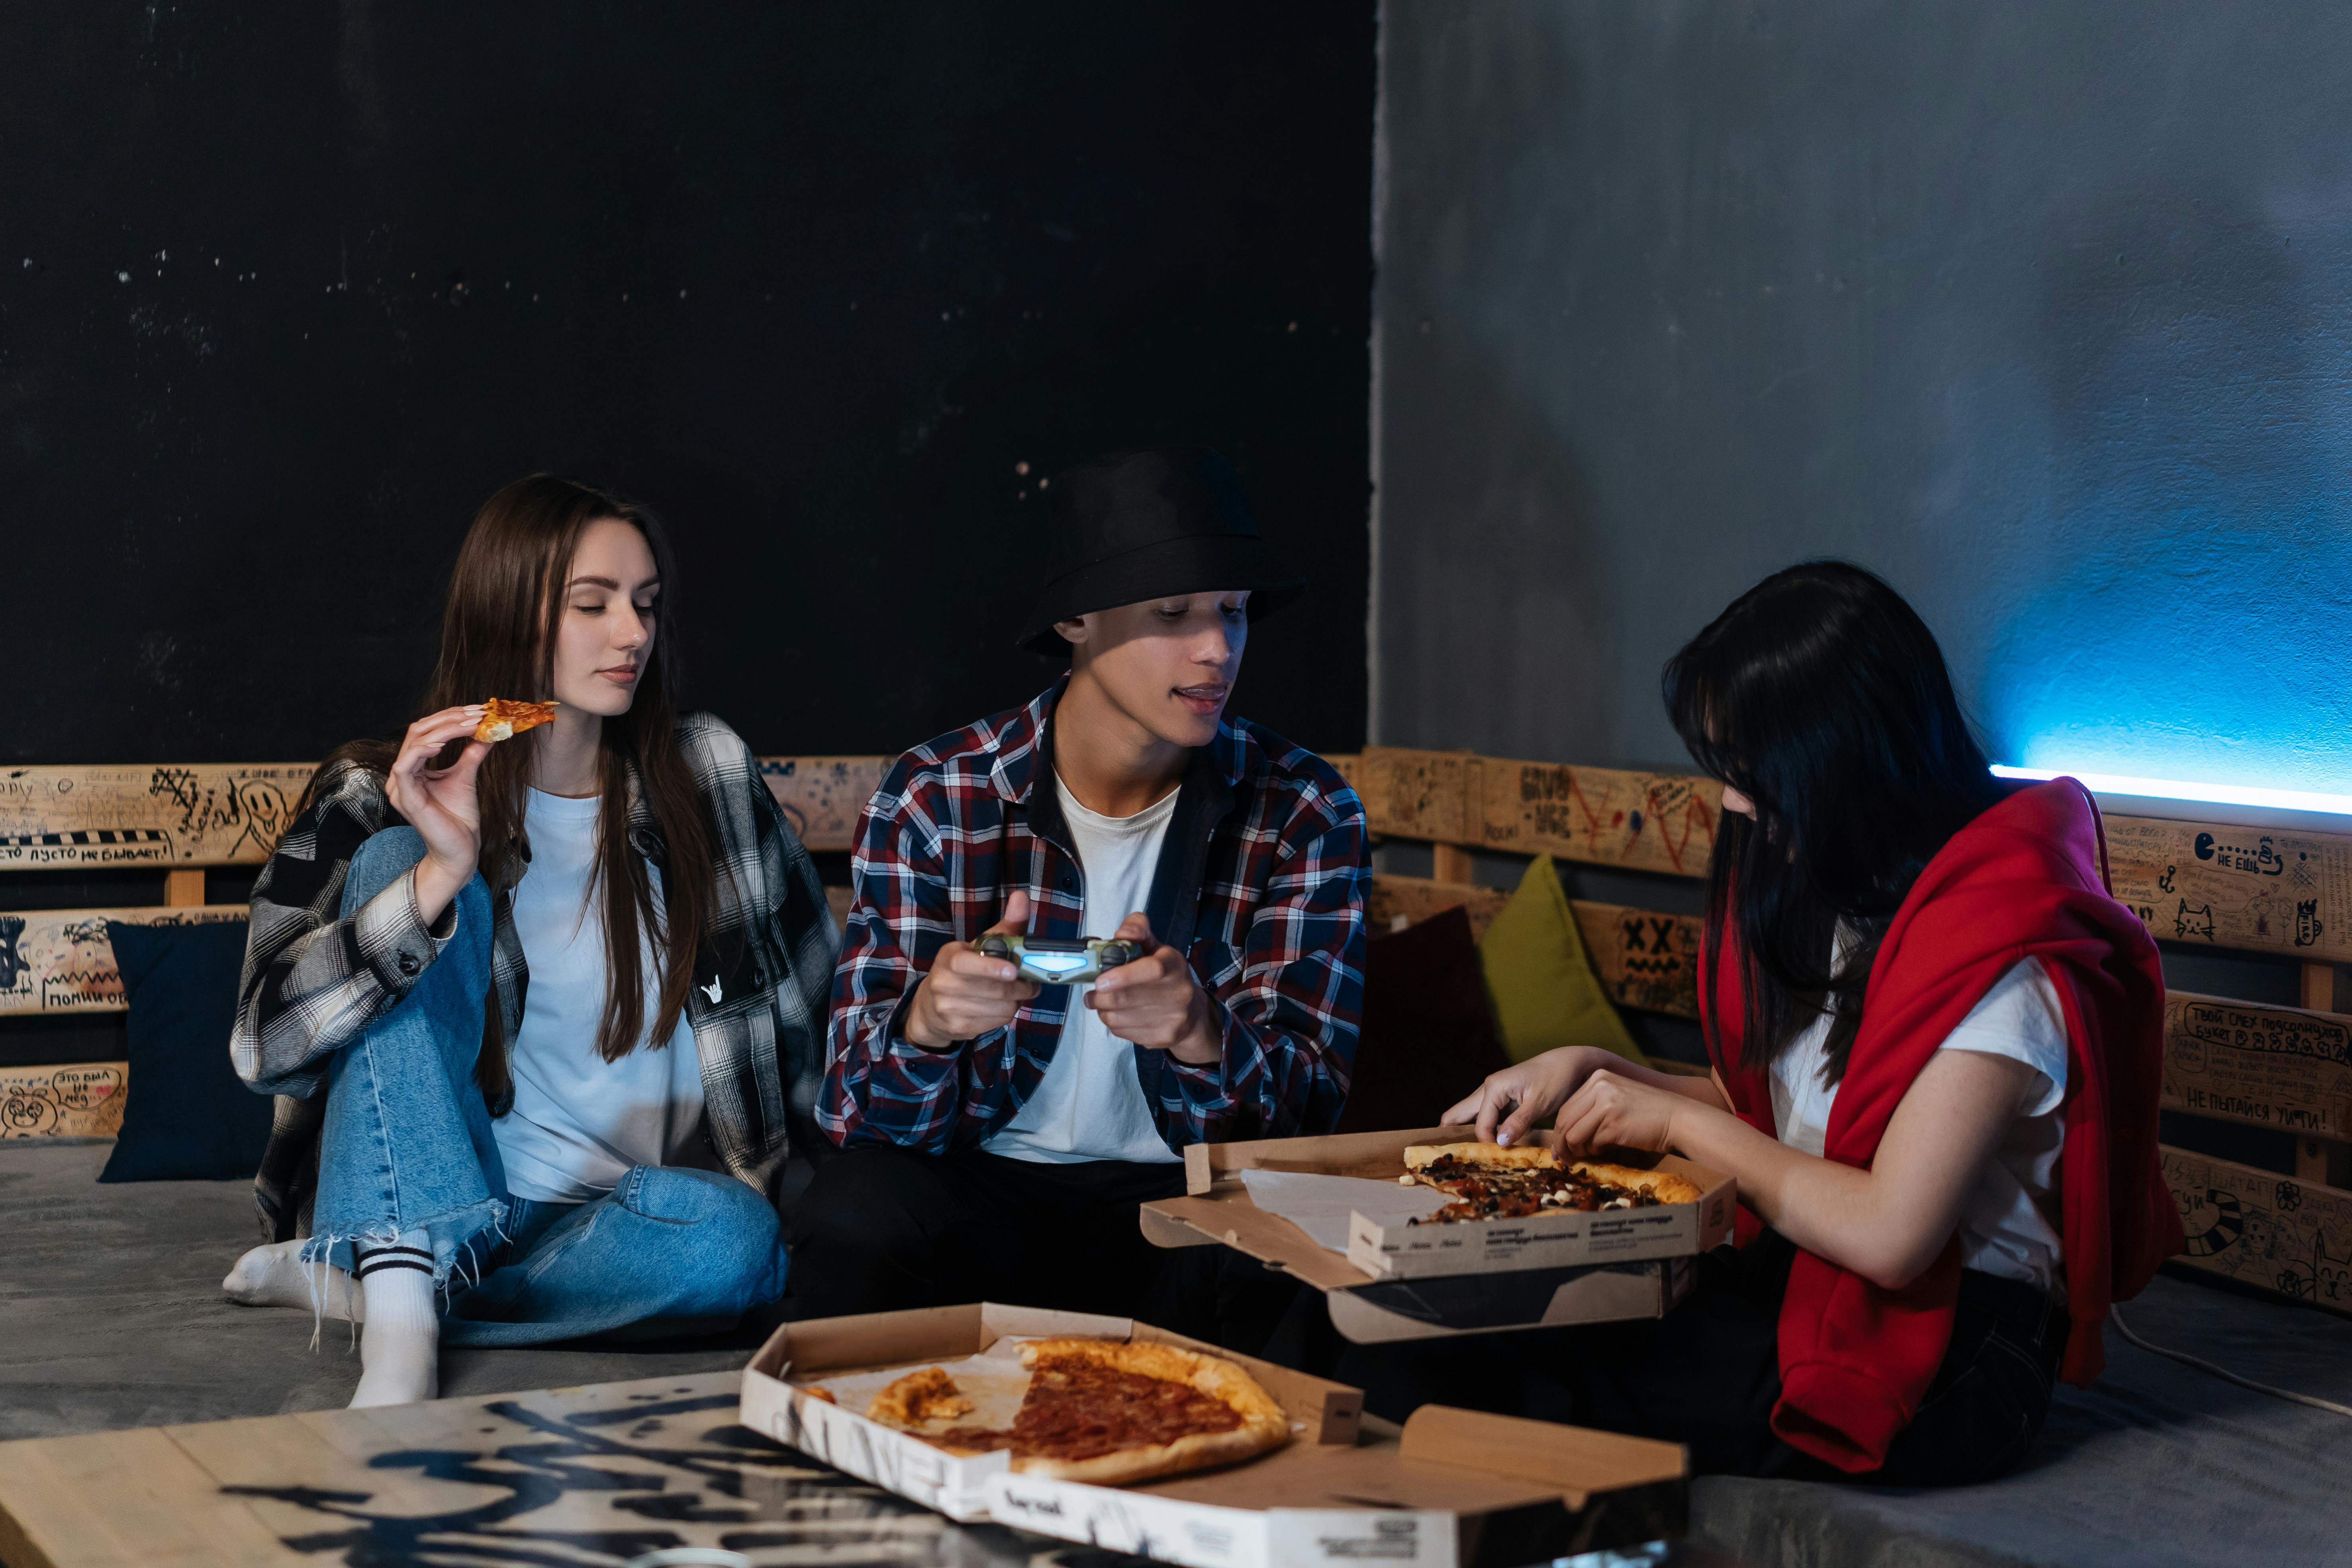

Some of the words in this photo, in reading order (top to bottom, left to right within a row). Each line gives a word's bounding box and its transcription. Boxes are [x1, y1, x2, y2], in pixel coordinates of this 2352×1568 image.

[30, 847, 76, 862] ПУСТО
[2217, 853, 2231, 867] НЕ
[2236, 858, 2260, 874] ЕШЬ
[2192, 1008, 2225, 1024] ТВОЙ
[2229, 1013, 2258, 1029] СМЕХ
[2187, 1086, 2207, 1108] НЕ
[2210, 1096, 2269, 1120] ПЫТАЙСЯ
